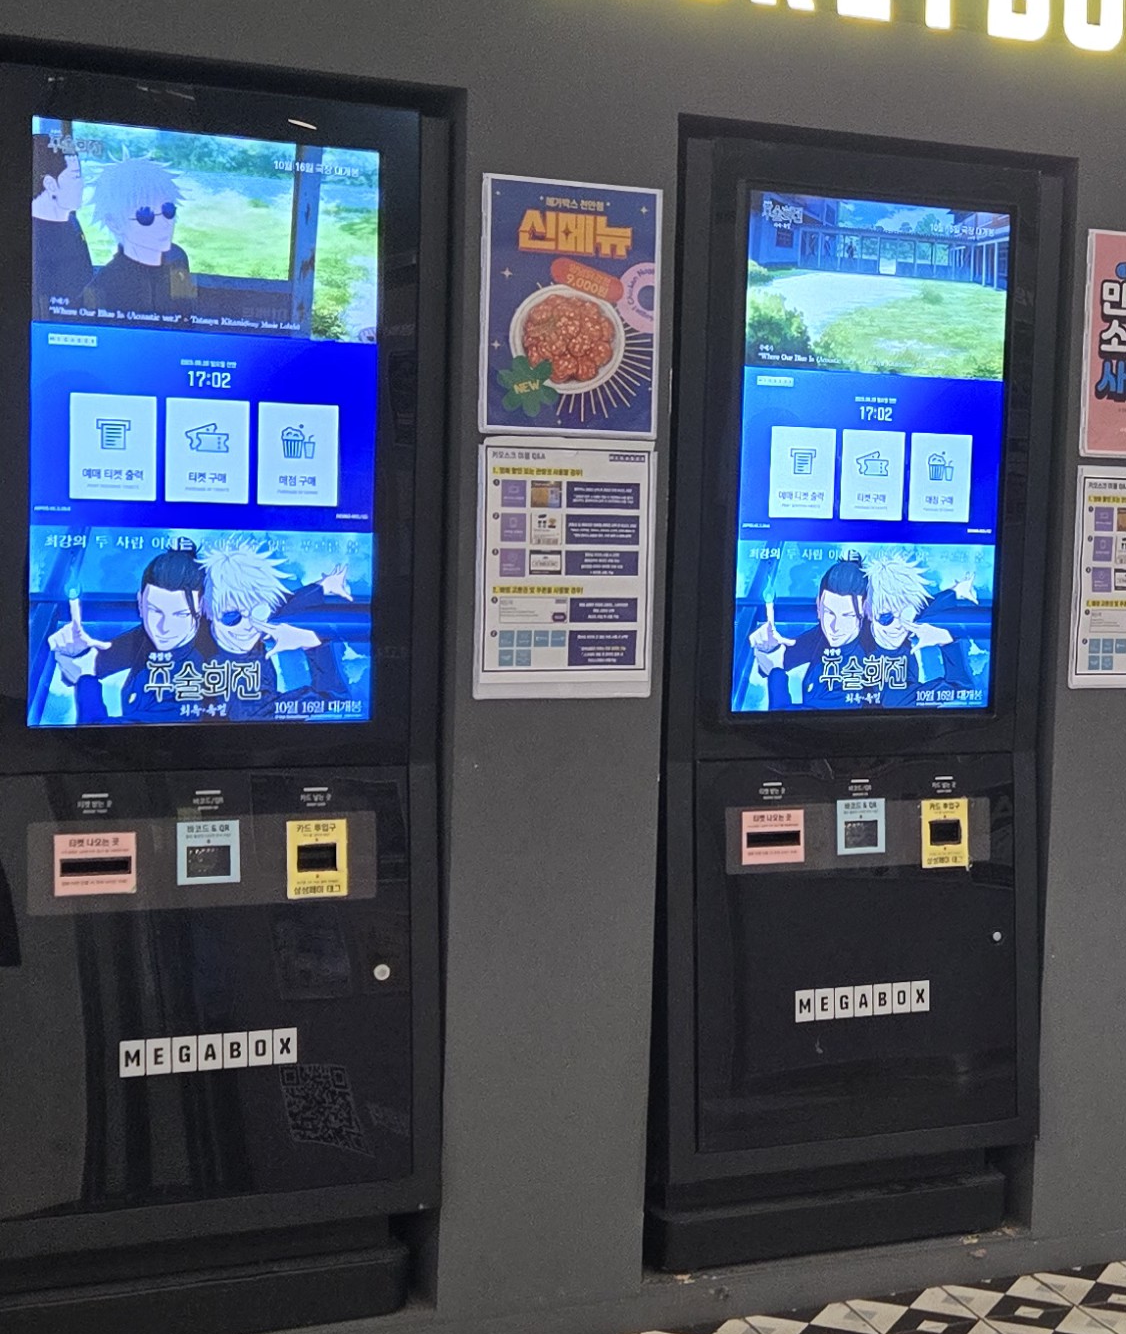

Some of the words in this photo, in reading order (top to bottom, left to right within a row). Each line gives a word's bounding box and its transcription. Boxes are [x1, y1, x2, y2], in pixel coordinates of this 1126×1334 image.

[518, 209, 633, 259] 신메뉴
[187, 370, 232, 389] 17:02
[513, 379, 540, 395] NEW
[859, 405, 893, 422] 17:02
[103, 469, 123, 481] 티켓
[188, 471, 207, 484] 티켓
[208, 472, 228, 484] 구매
[298, 475, 317, 488] 구매
[115, 535, 144, 550] 사람
[143, 658, 262, 702] 주술회전
[819, 654, 908, 692] 주술회전
[301, 700, 325, 714] 16일
[327, 699, 363, 714] 대개봉
[218, 824, 230, 833] QR
[68, 838, 84, 848] 티켓
[85, 837, 110, 847] 나오는
[798, 986, 926, 1015] MEGABOX
[123, 1035, 293, 1069] MEGABOX
